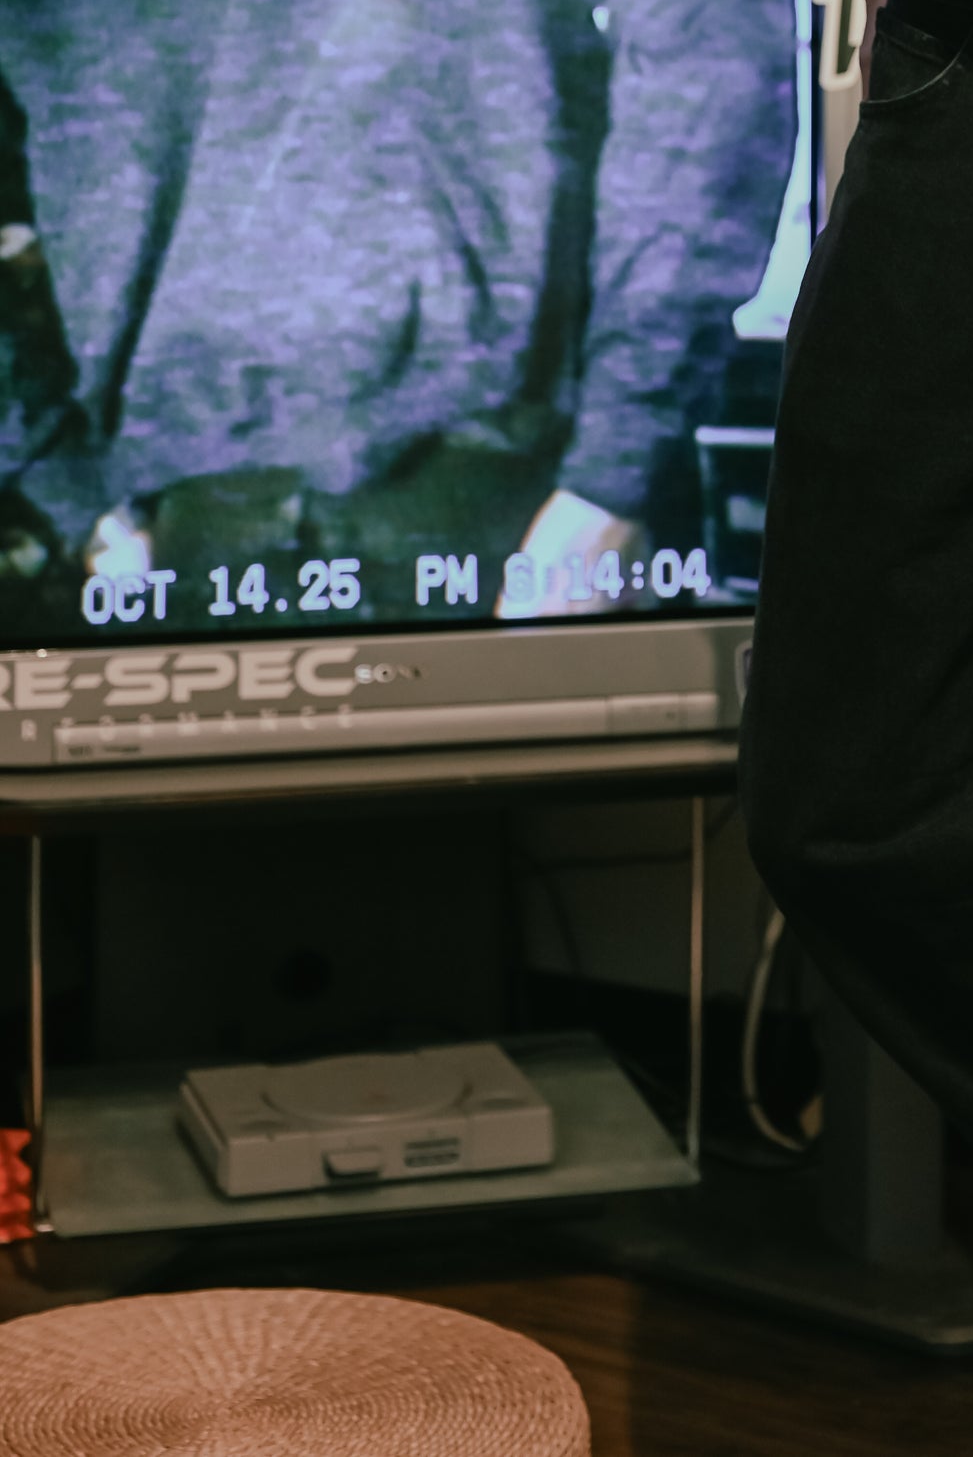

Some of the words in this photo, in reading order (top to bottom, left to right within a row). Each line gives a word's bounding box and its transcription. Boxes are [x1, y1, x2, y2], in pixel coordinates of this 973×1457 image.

[82, 569, 177, 625] OCT
[208, 557, 361, 617] 14.25
[416, 553, 478, 606] PM
[0, 646, 358, 710] E-SPEC
